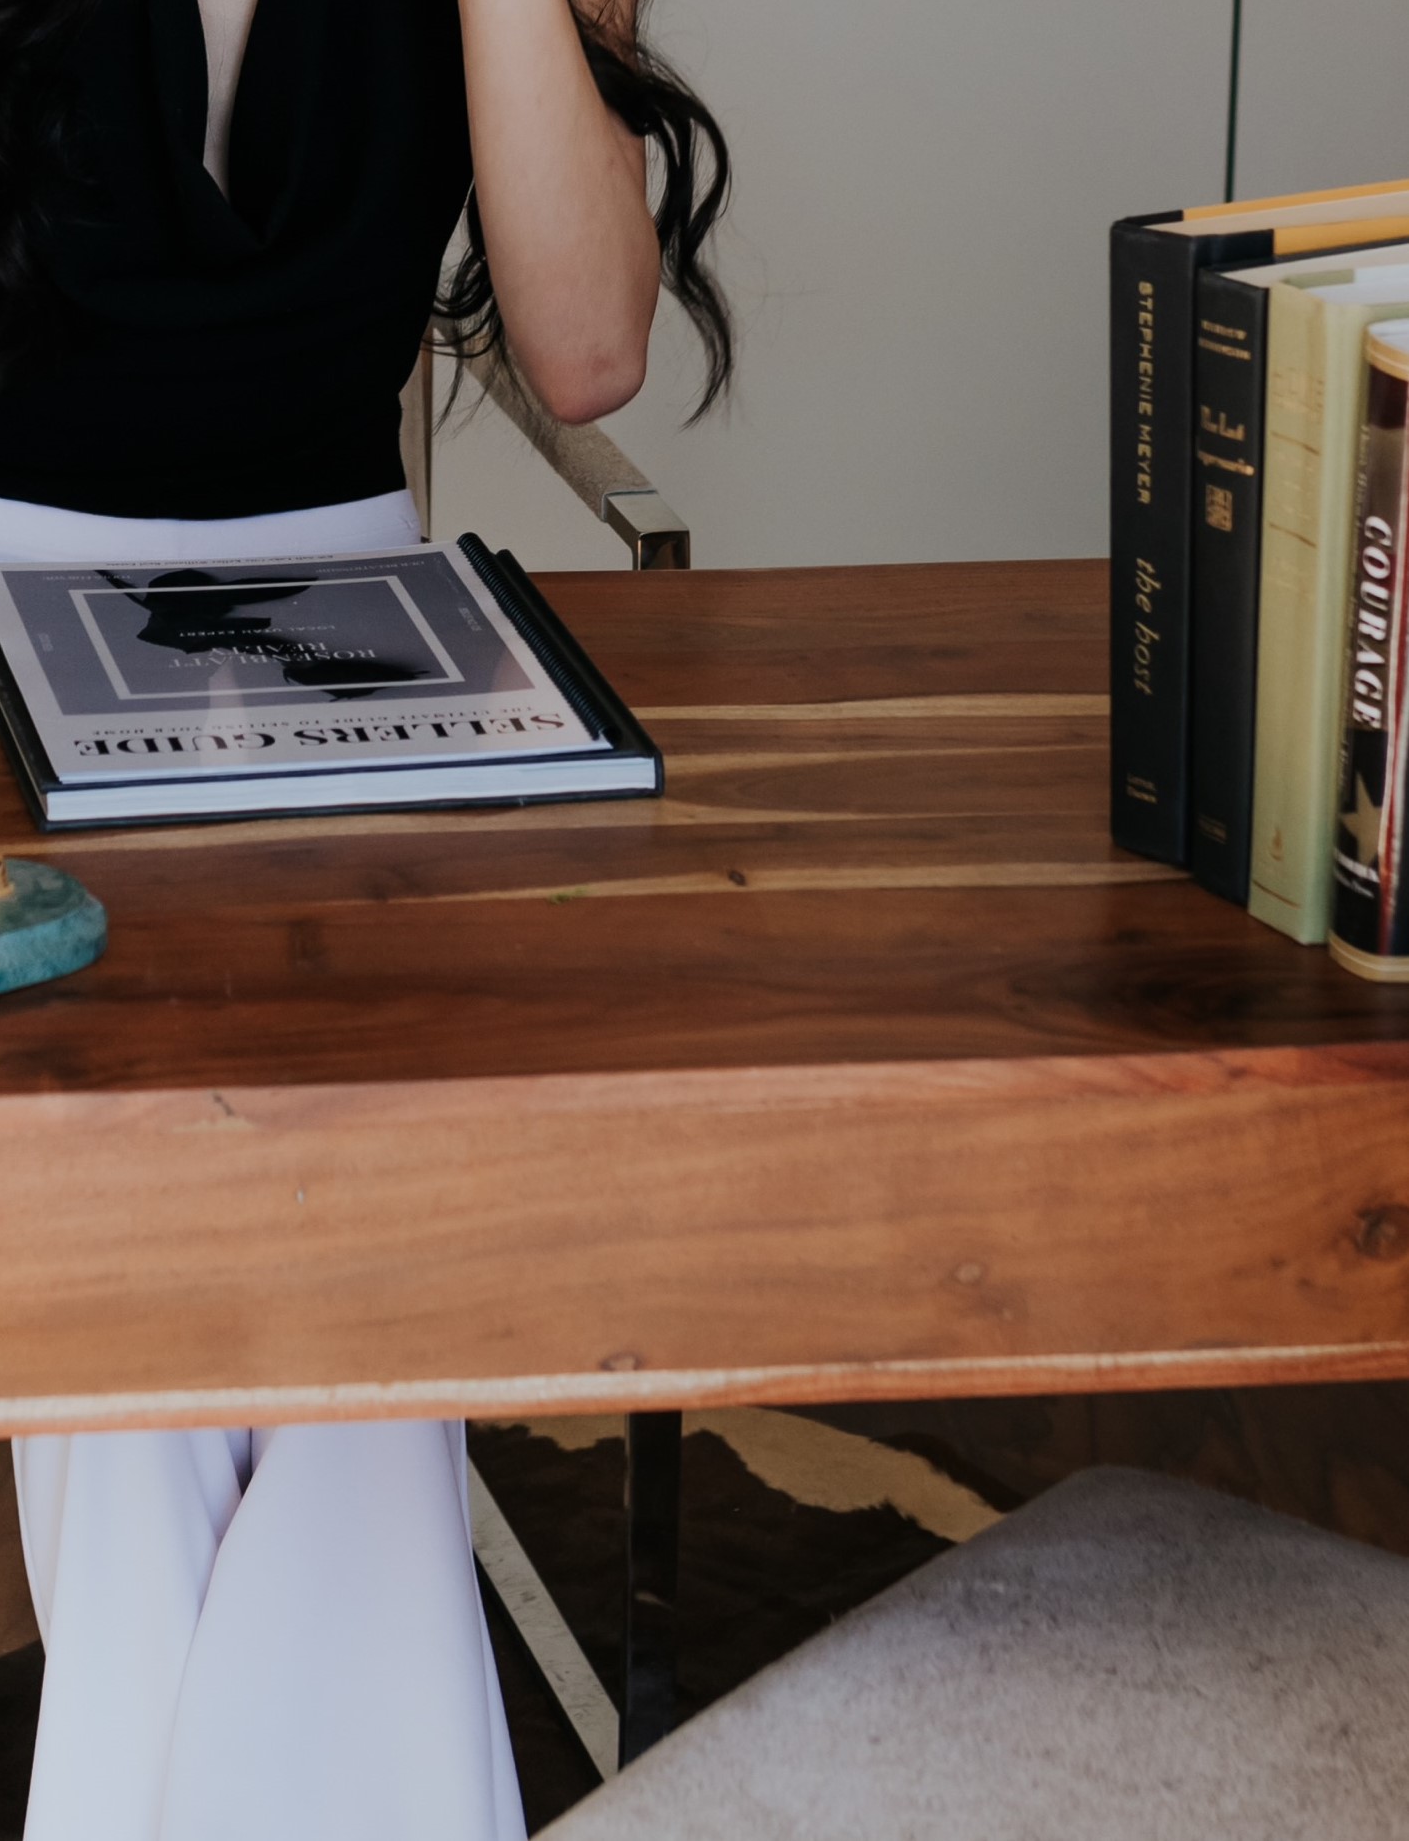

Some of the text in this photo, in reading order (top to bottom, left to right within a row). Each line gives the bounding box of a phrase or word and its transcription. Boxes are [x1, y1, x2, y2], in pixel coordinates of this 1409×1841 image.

[1137, 281, 1154, 505] STEPHENIE MEYER
[179, 629, 236, 637] EXPERT
[1134, 558, 1161, 695] the host
[1352, 515, 1393, 729] COURAGE
[168, 649, 376, 668] ROSENBLATT
[208, 642, 327, 656] REALTY
[73, 713, 565, 756] SELLERS GUIDE
